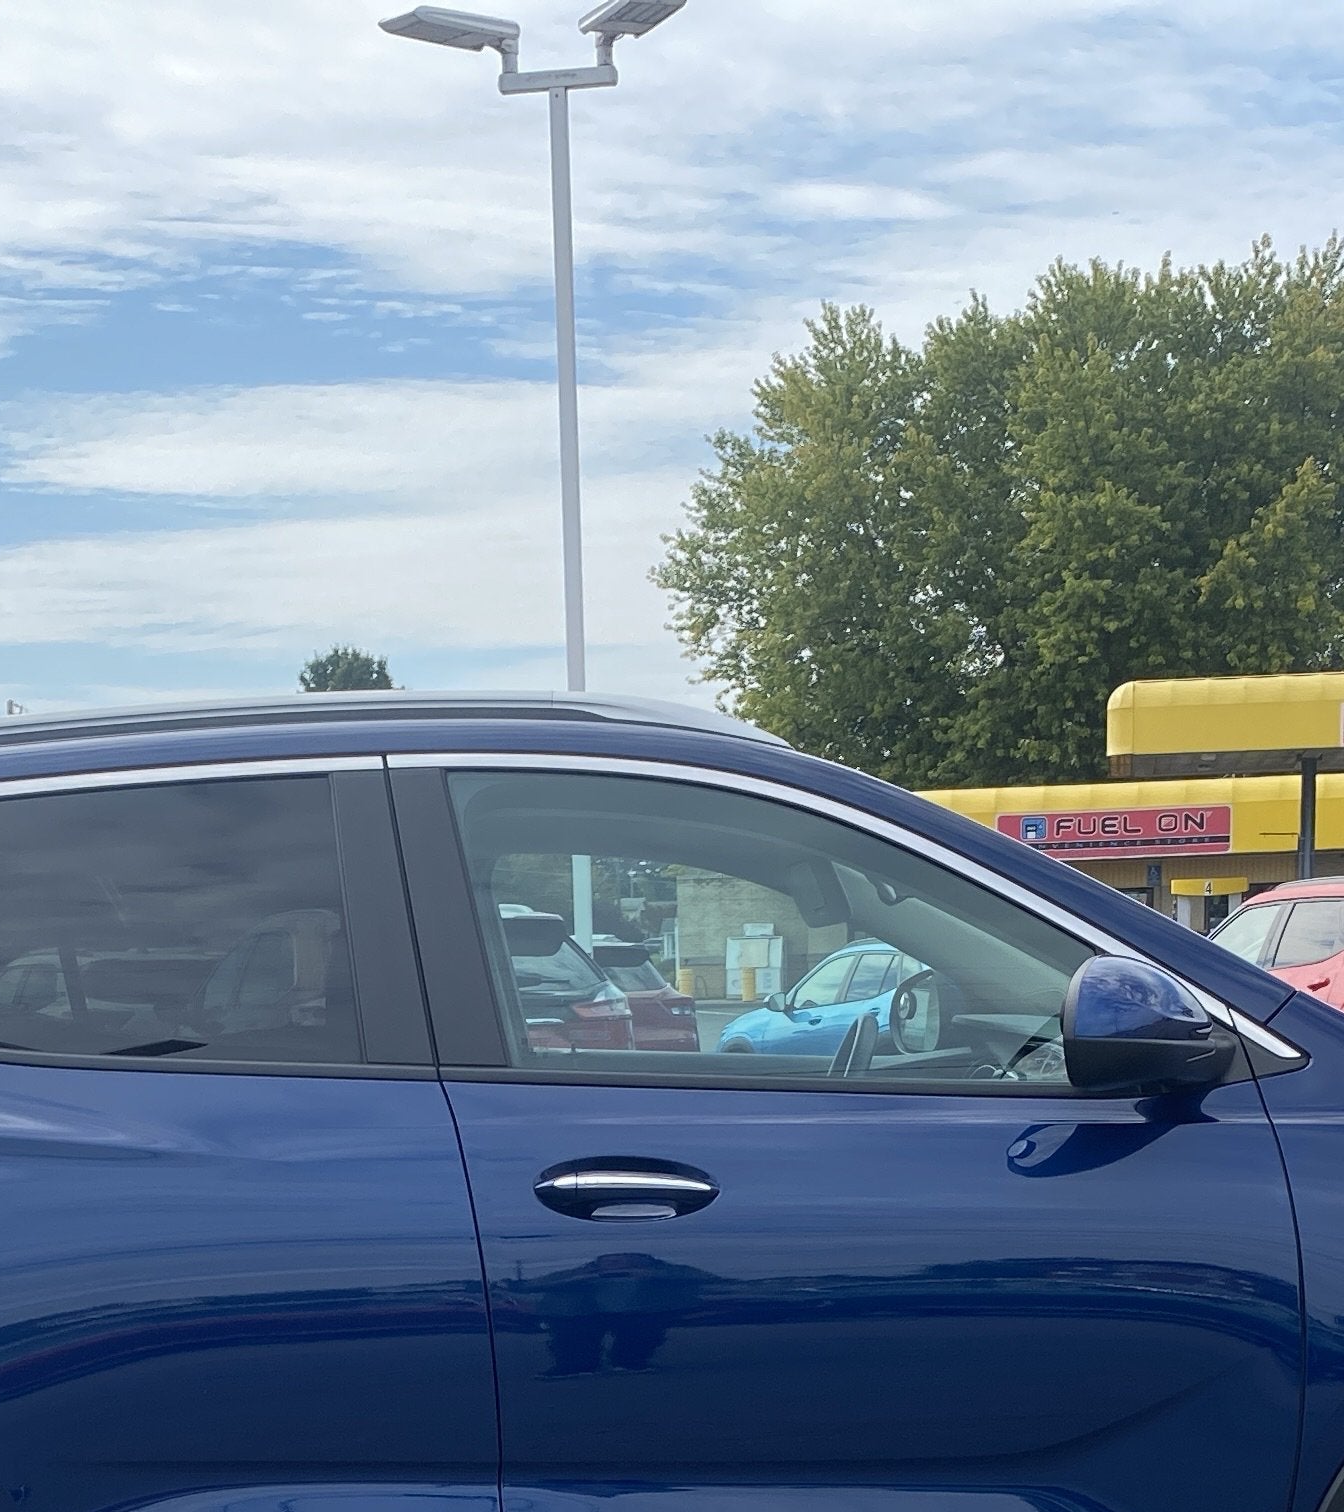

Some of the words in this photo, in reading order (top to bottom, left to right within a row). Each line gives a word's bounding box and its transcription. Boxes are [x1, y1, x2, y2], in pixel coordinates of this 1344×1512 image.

[1055, 815, 1142, 836] FUEL
[1157, 811, 1206, 832] ON
[1037, 840, 1142, 850] NVENIENCE
[1155, 836, 1210, 845] STORE
[1205, 881, 1213, 895] 4
